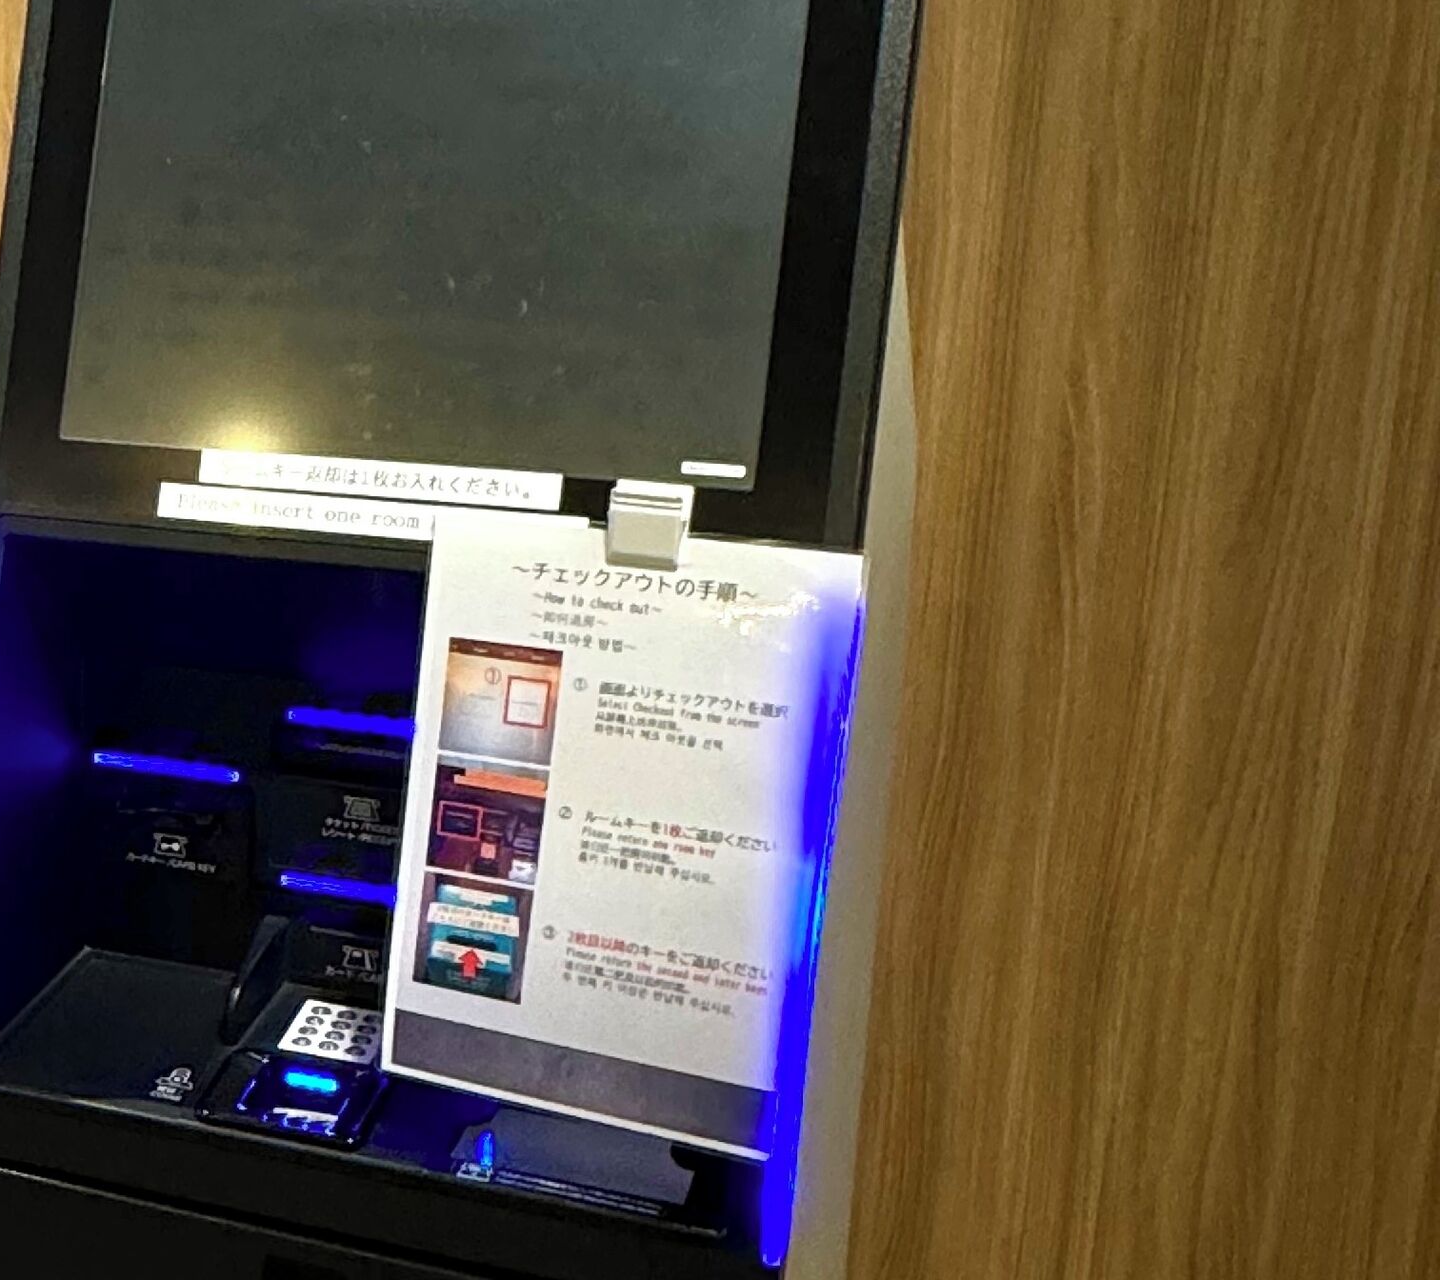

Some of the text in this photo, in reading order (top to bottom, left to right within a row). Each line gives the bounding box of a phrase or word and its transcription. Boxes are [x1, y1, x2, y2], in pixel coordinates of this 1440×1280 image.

[252, 500, 314, 521] insert
[324, 508, 360, 524] one
[371, 513, 420, 531] room
[571, 593, 584, 608] to
[589, 596, 623, 612] check
